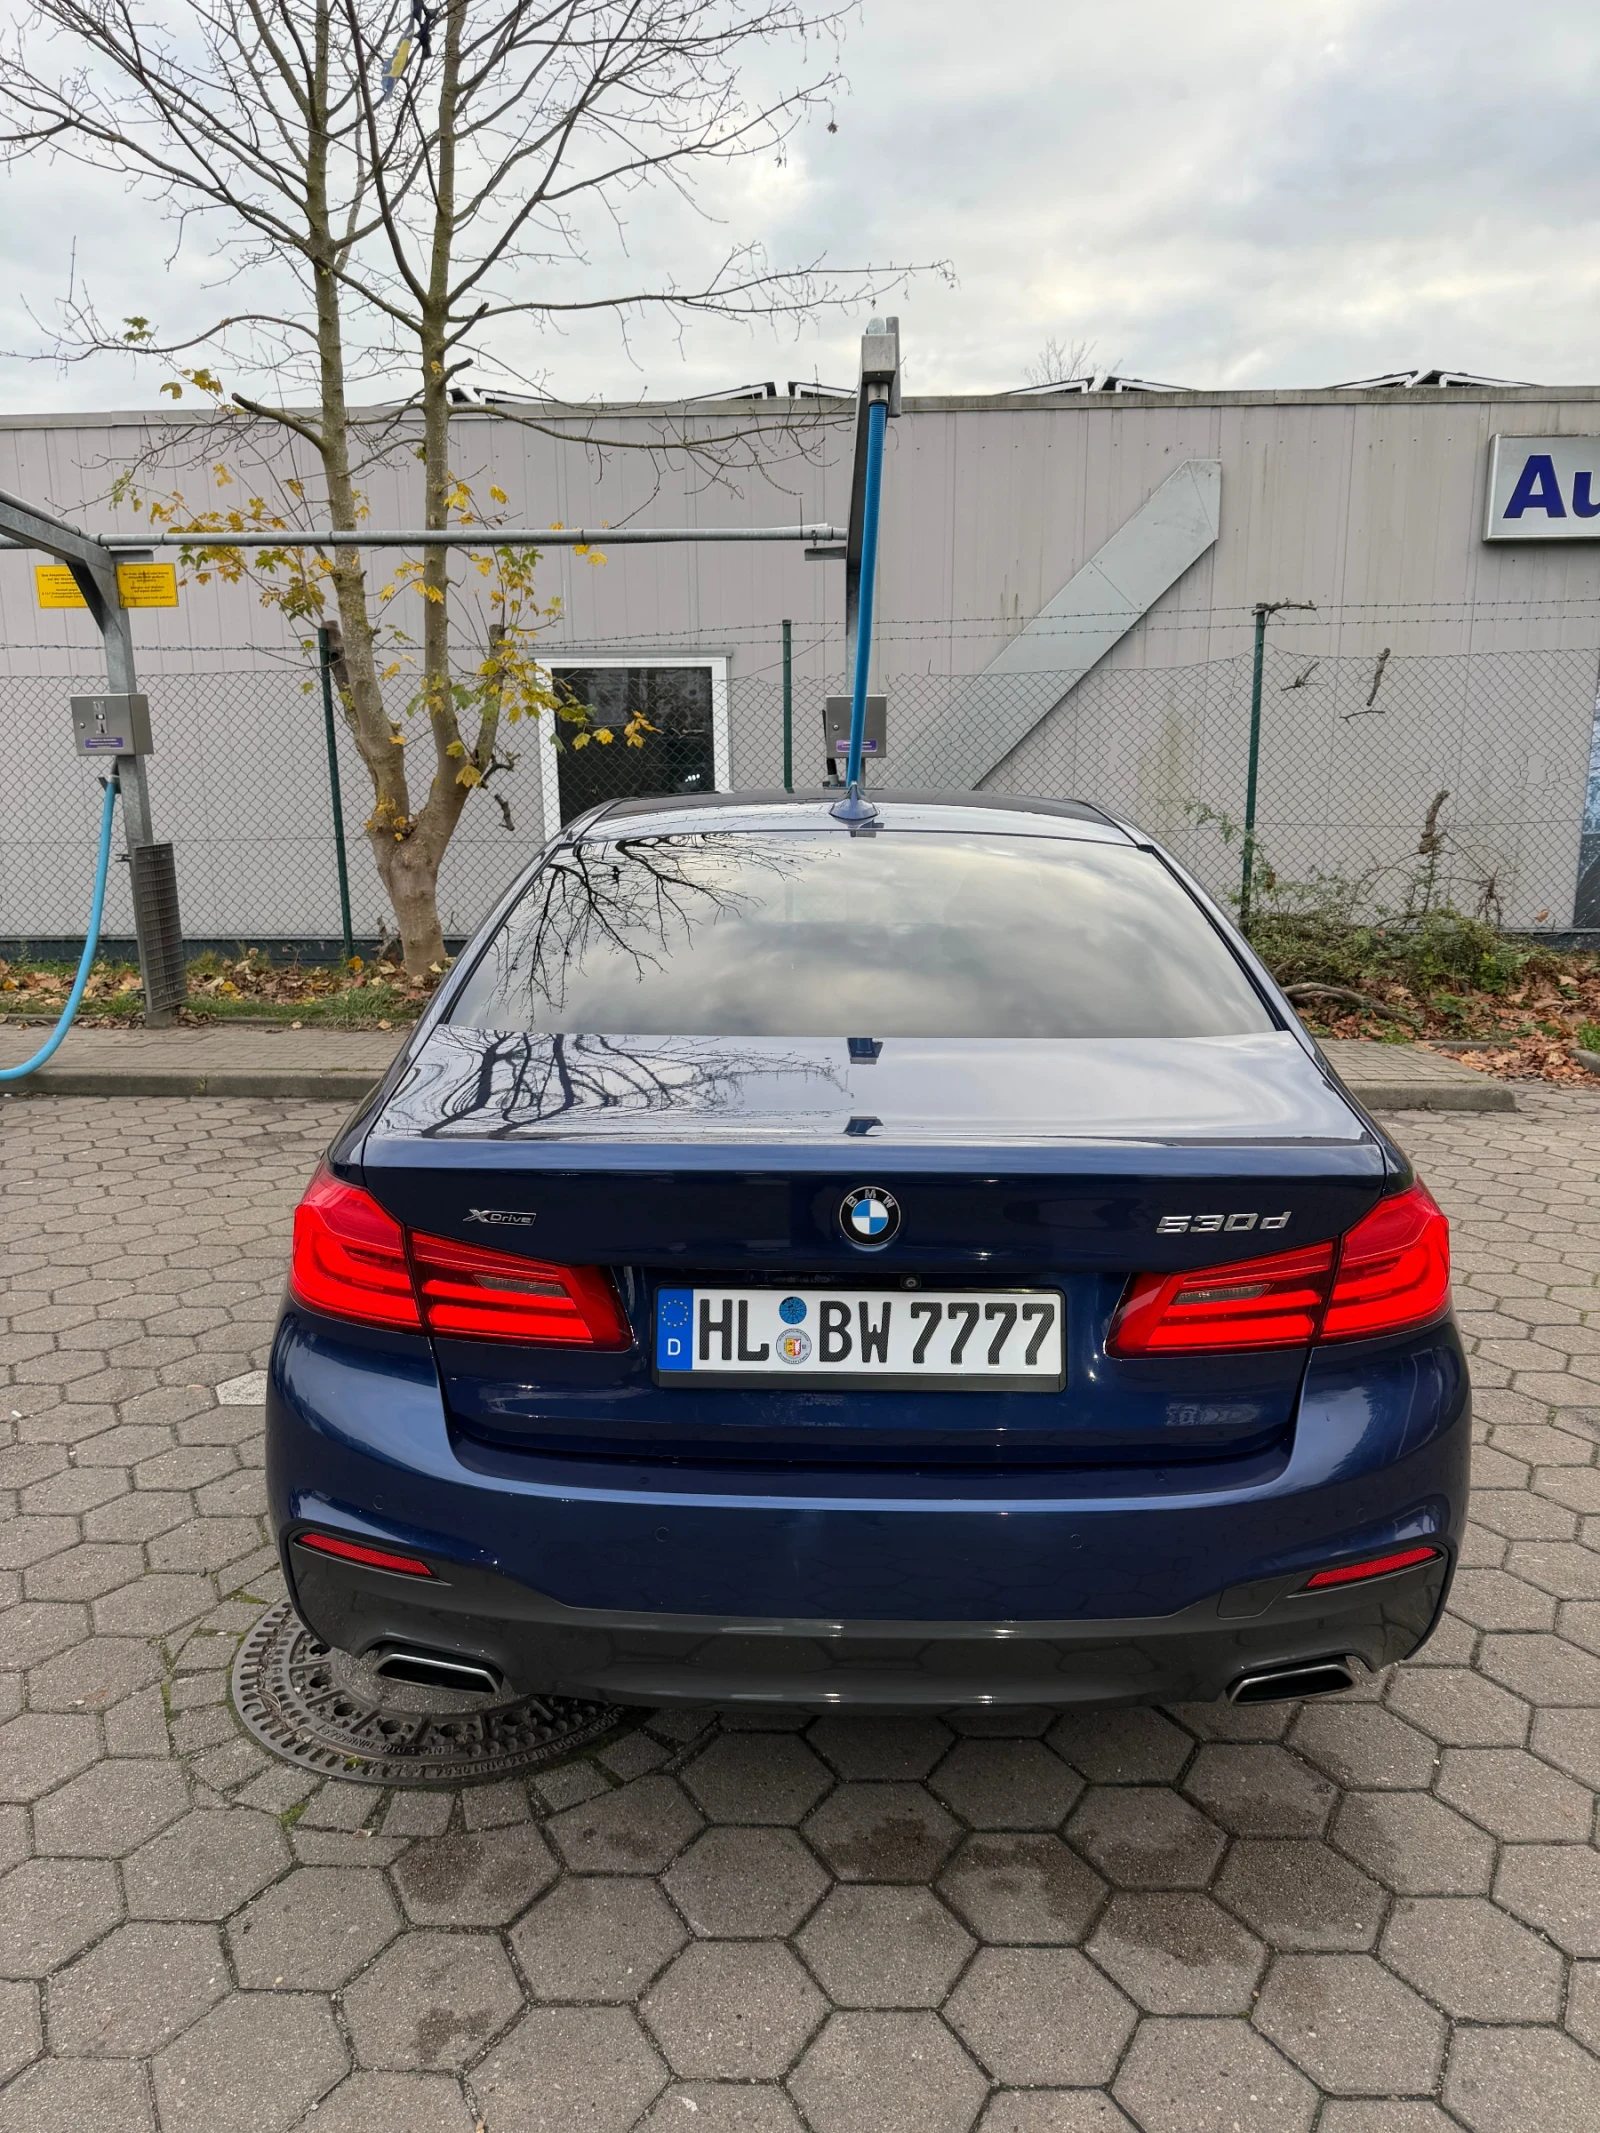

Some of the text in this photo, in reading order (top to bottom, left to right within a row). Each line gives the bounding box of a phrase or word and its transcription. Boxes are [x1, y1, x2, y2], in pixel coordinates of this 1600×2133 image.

[846, 1189, 895, 1209] BMW
[1156, 1211, 1292, 1233] 530d
[699, 1299, 1055, 1365] HL BW 7777
[667, 1338, 681, 1356] D
